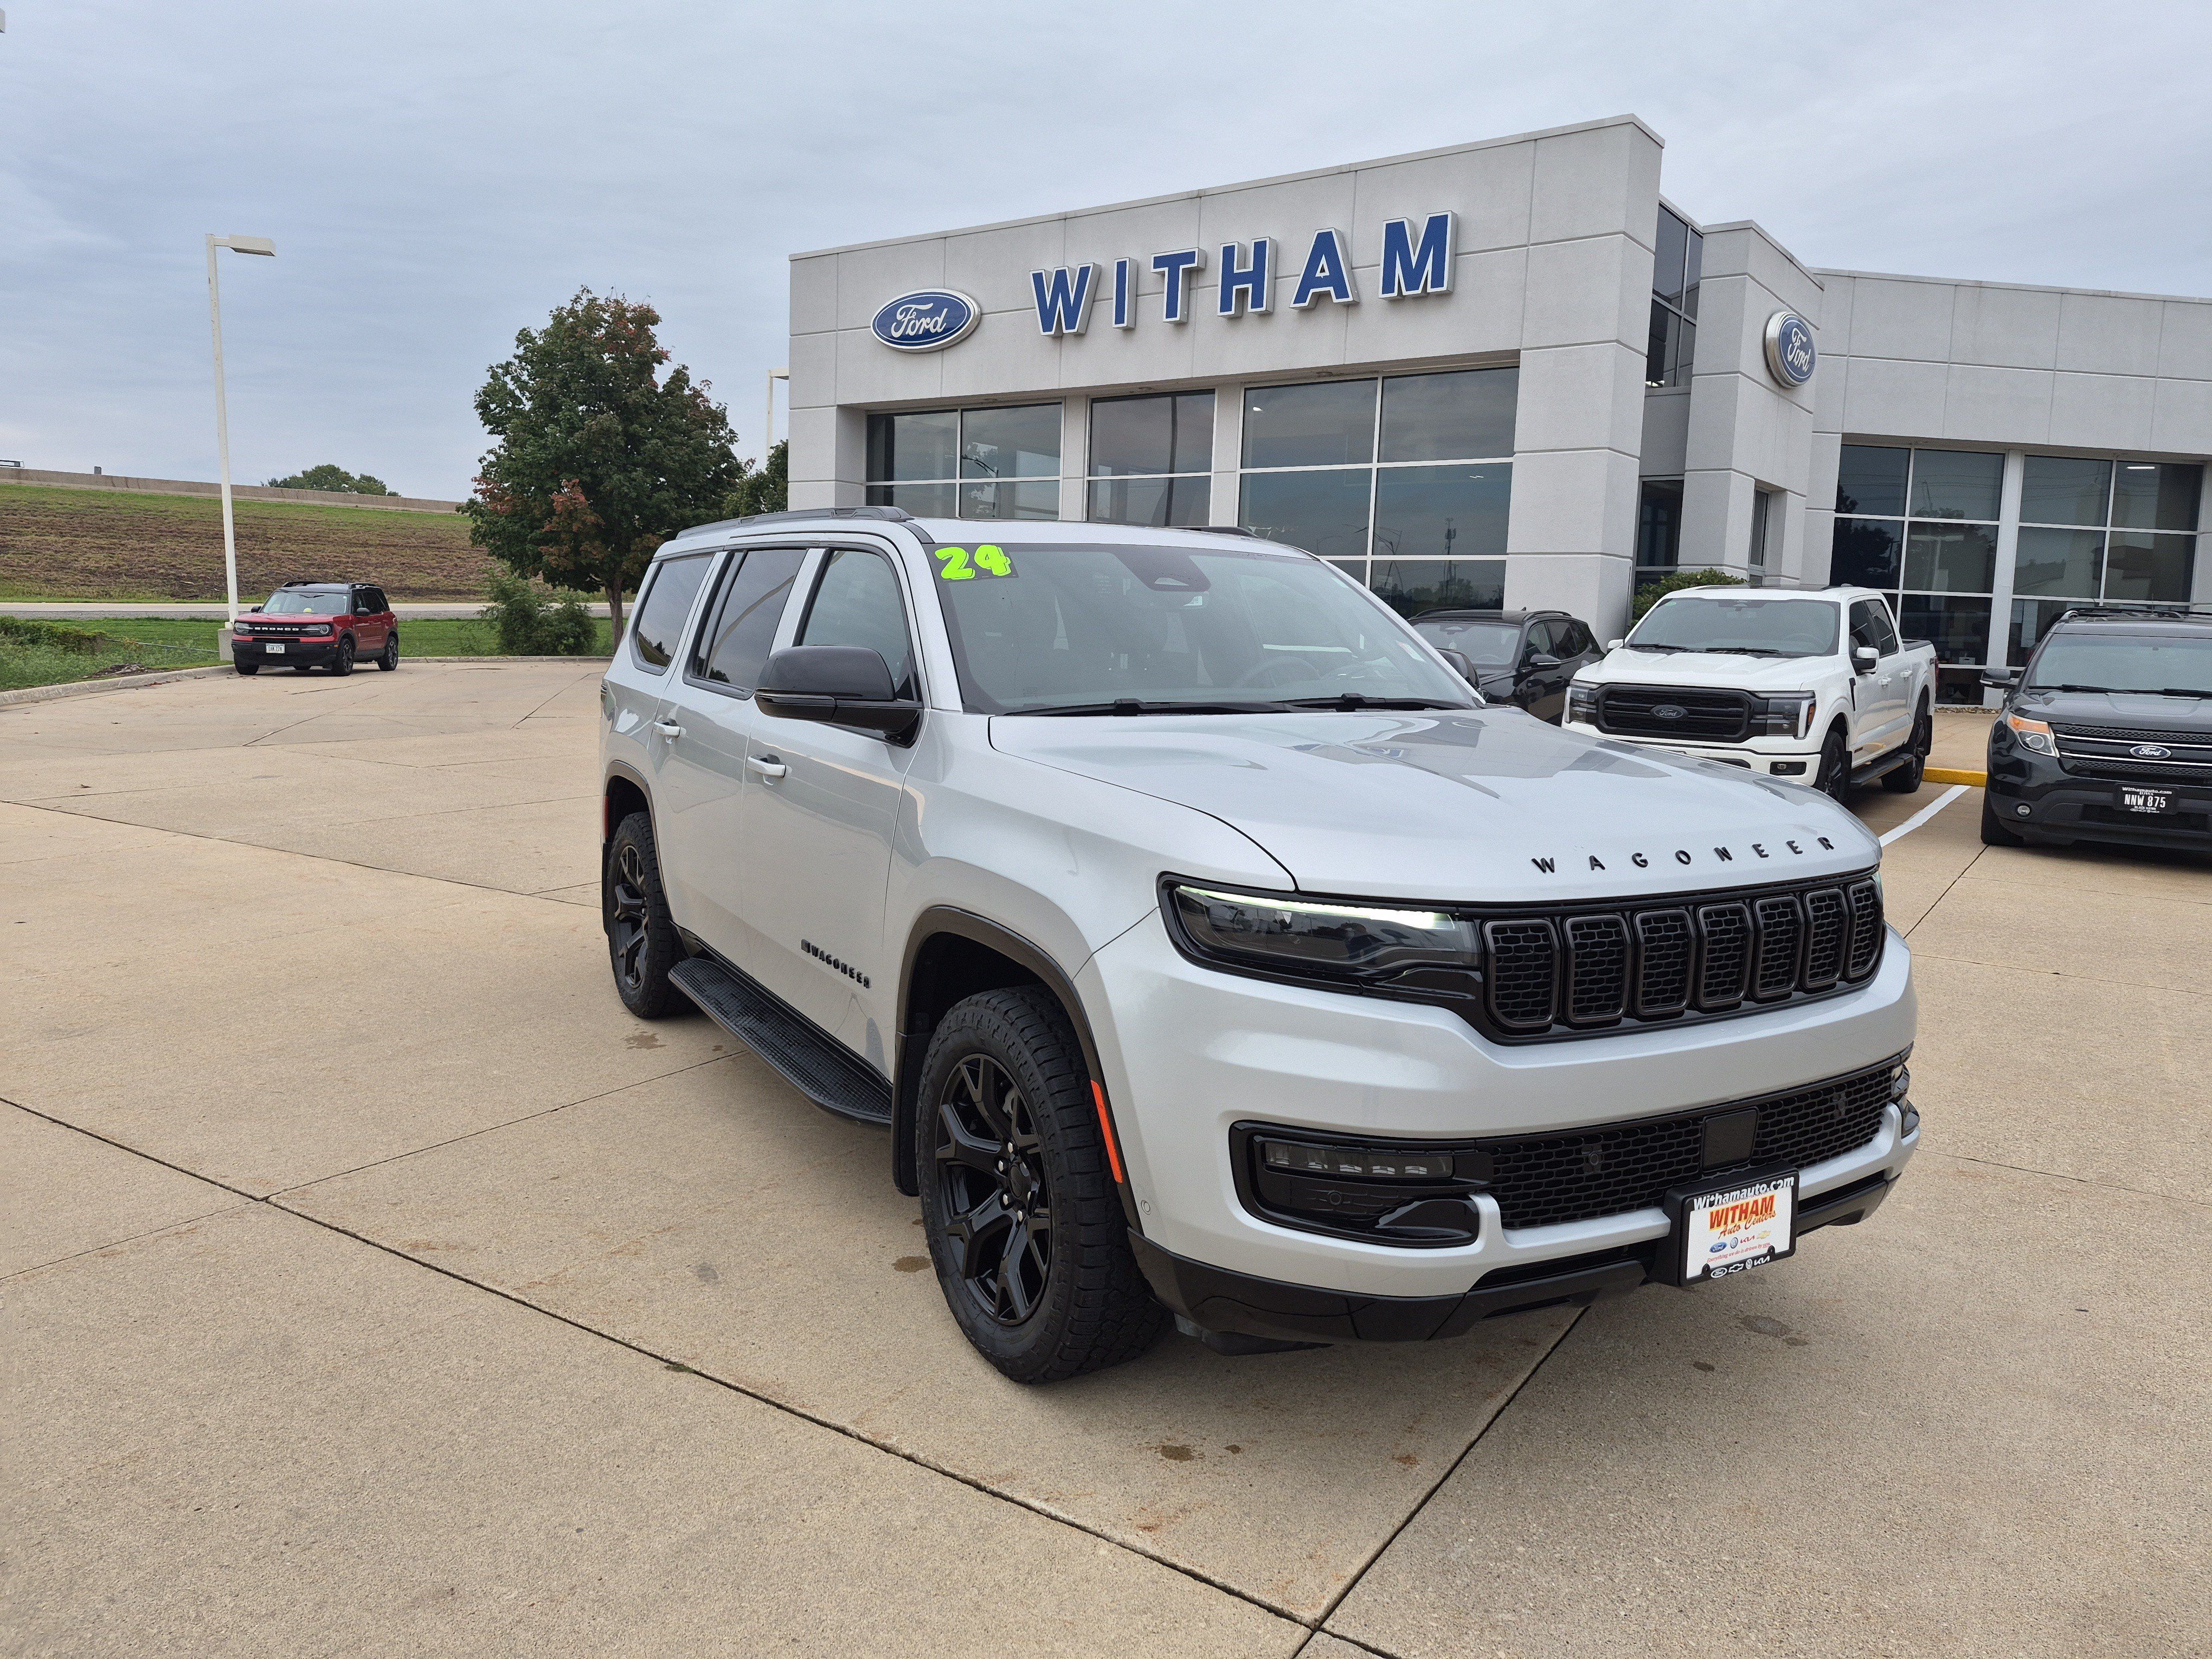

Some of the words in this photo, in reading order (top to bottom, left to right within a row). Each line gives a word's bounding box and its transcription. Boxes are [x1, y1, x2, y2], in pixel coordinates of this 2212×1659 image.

[1029, 210, 1457, 338] WITHAM
[891, 303, 948, 338] Ford
[1787, 327, 1811, 373] Ford
[935, 544, 1012, 580] 24
[1659, 709, 1678, 717] Ford
[2139, 747, 2162, 756] Ford
[2124, 794, 2145, 806] NNW
[2147, 795, 2166, 808] 875
[1531, 837, 1835, 874] WAGONEER
[811, 944, 871, 989] WAGONEER
[1709, 1194, 1775, 1230] WITHAM
[1718, 1222, 1741, 1240] Auto
[1744, 1210, 1777, 1230] Centers
